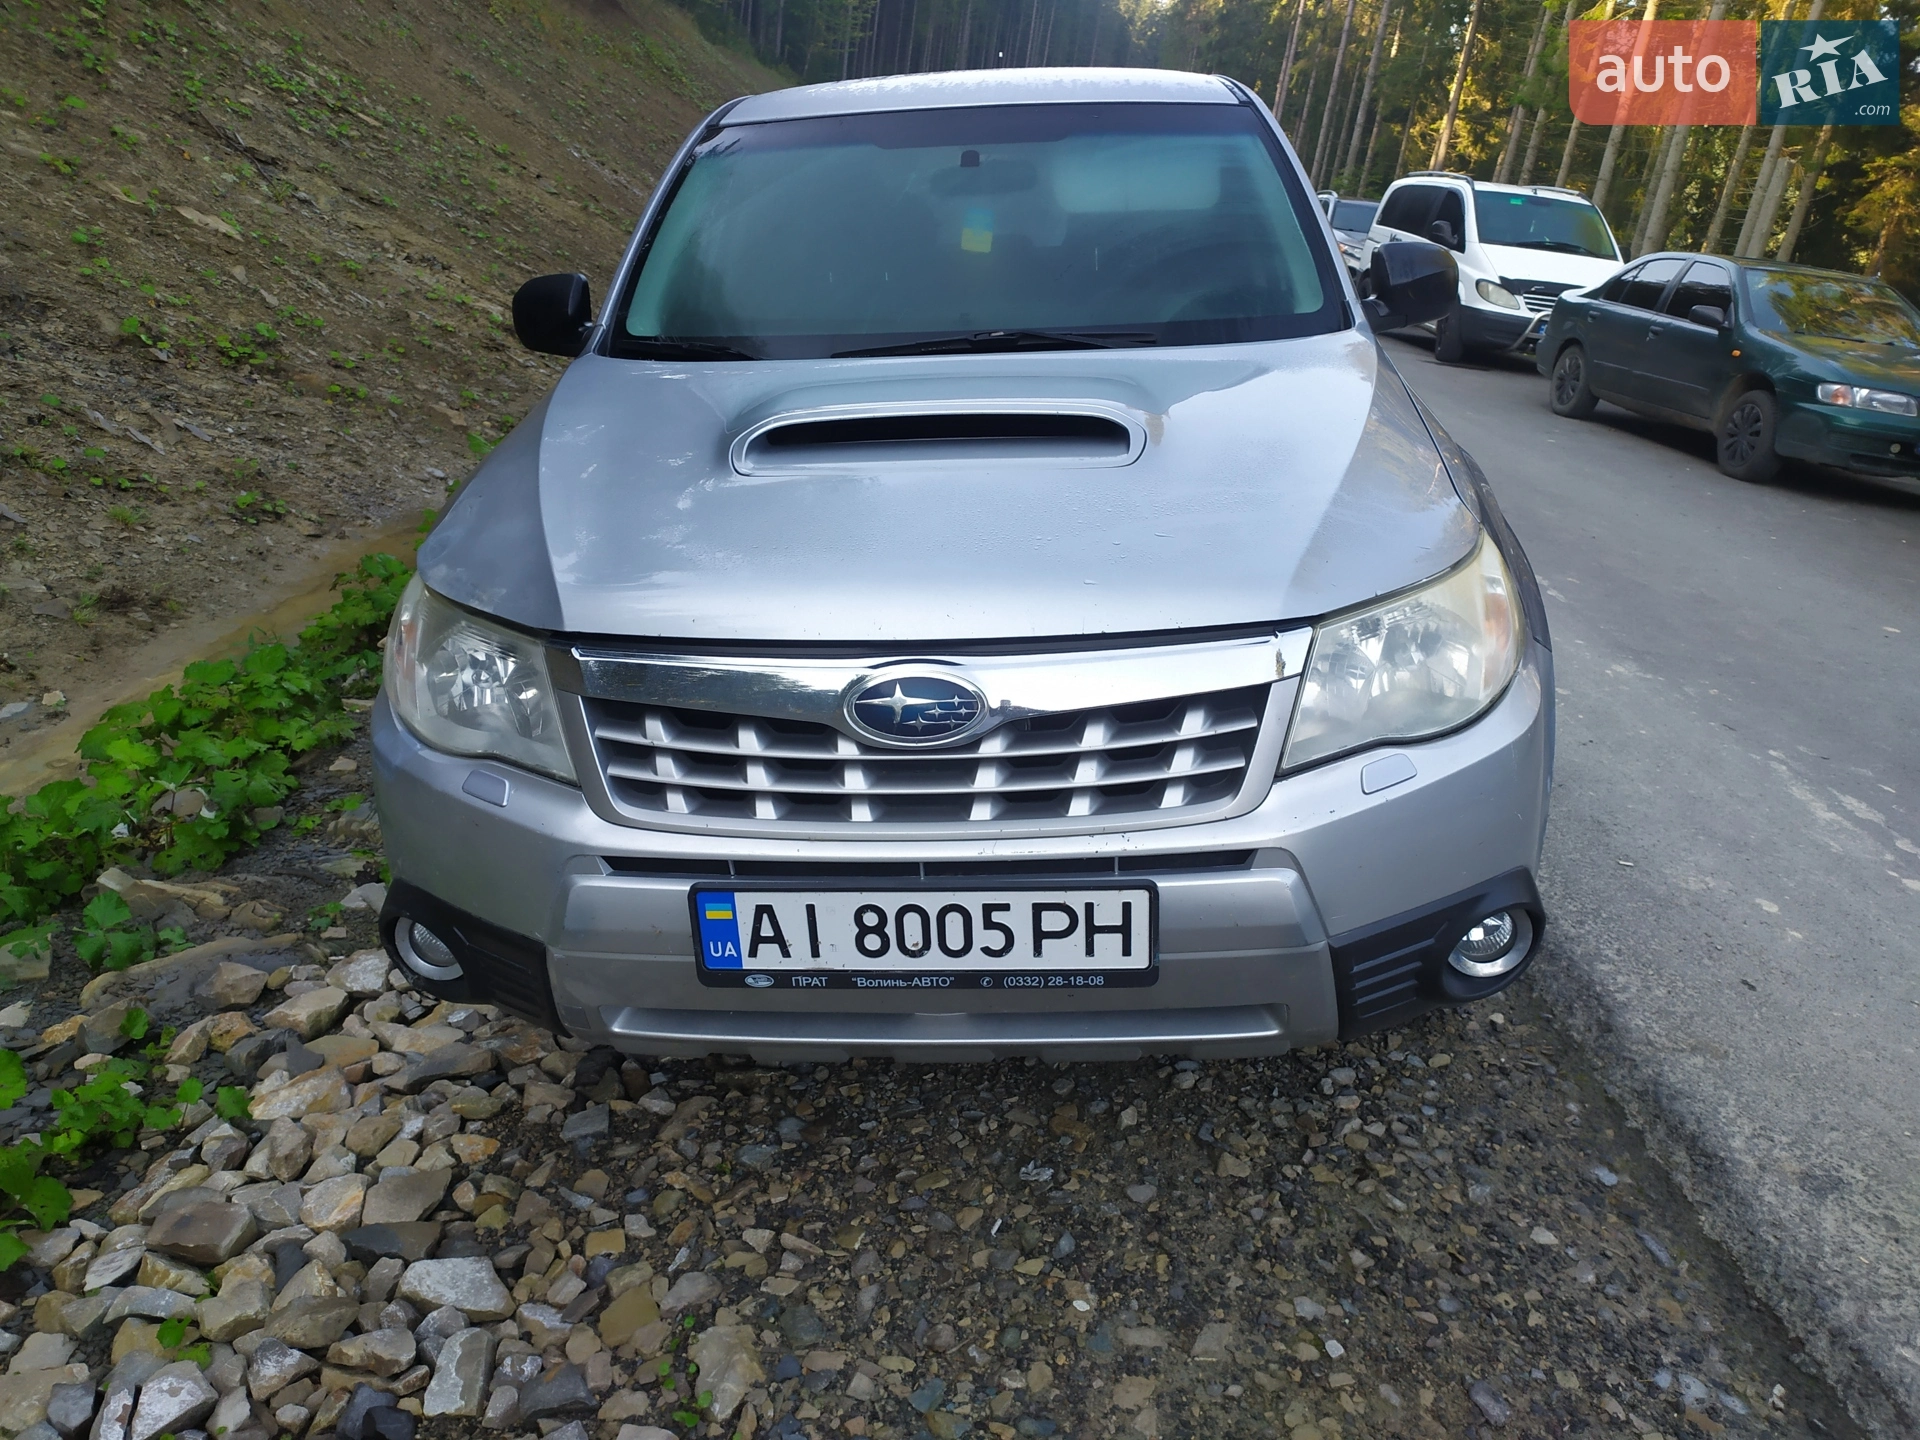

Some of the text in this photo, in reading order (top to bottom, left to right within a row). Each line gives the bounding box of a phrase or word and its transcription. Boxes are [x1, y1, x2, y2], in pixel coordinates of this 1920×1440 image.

[747, 903, 821, 959] AI
[710, 940, 738, 958] UA
[791, 976, 828, 987] ПРАТ
[1003, 976, 1044, 988] (0332)
[1047, 975, 1105, 986] 28-18-08
